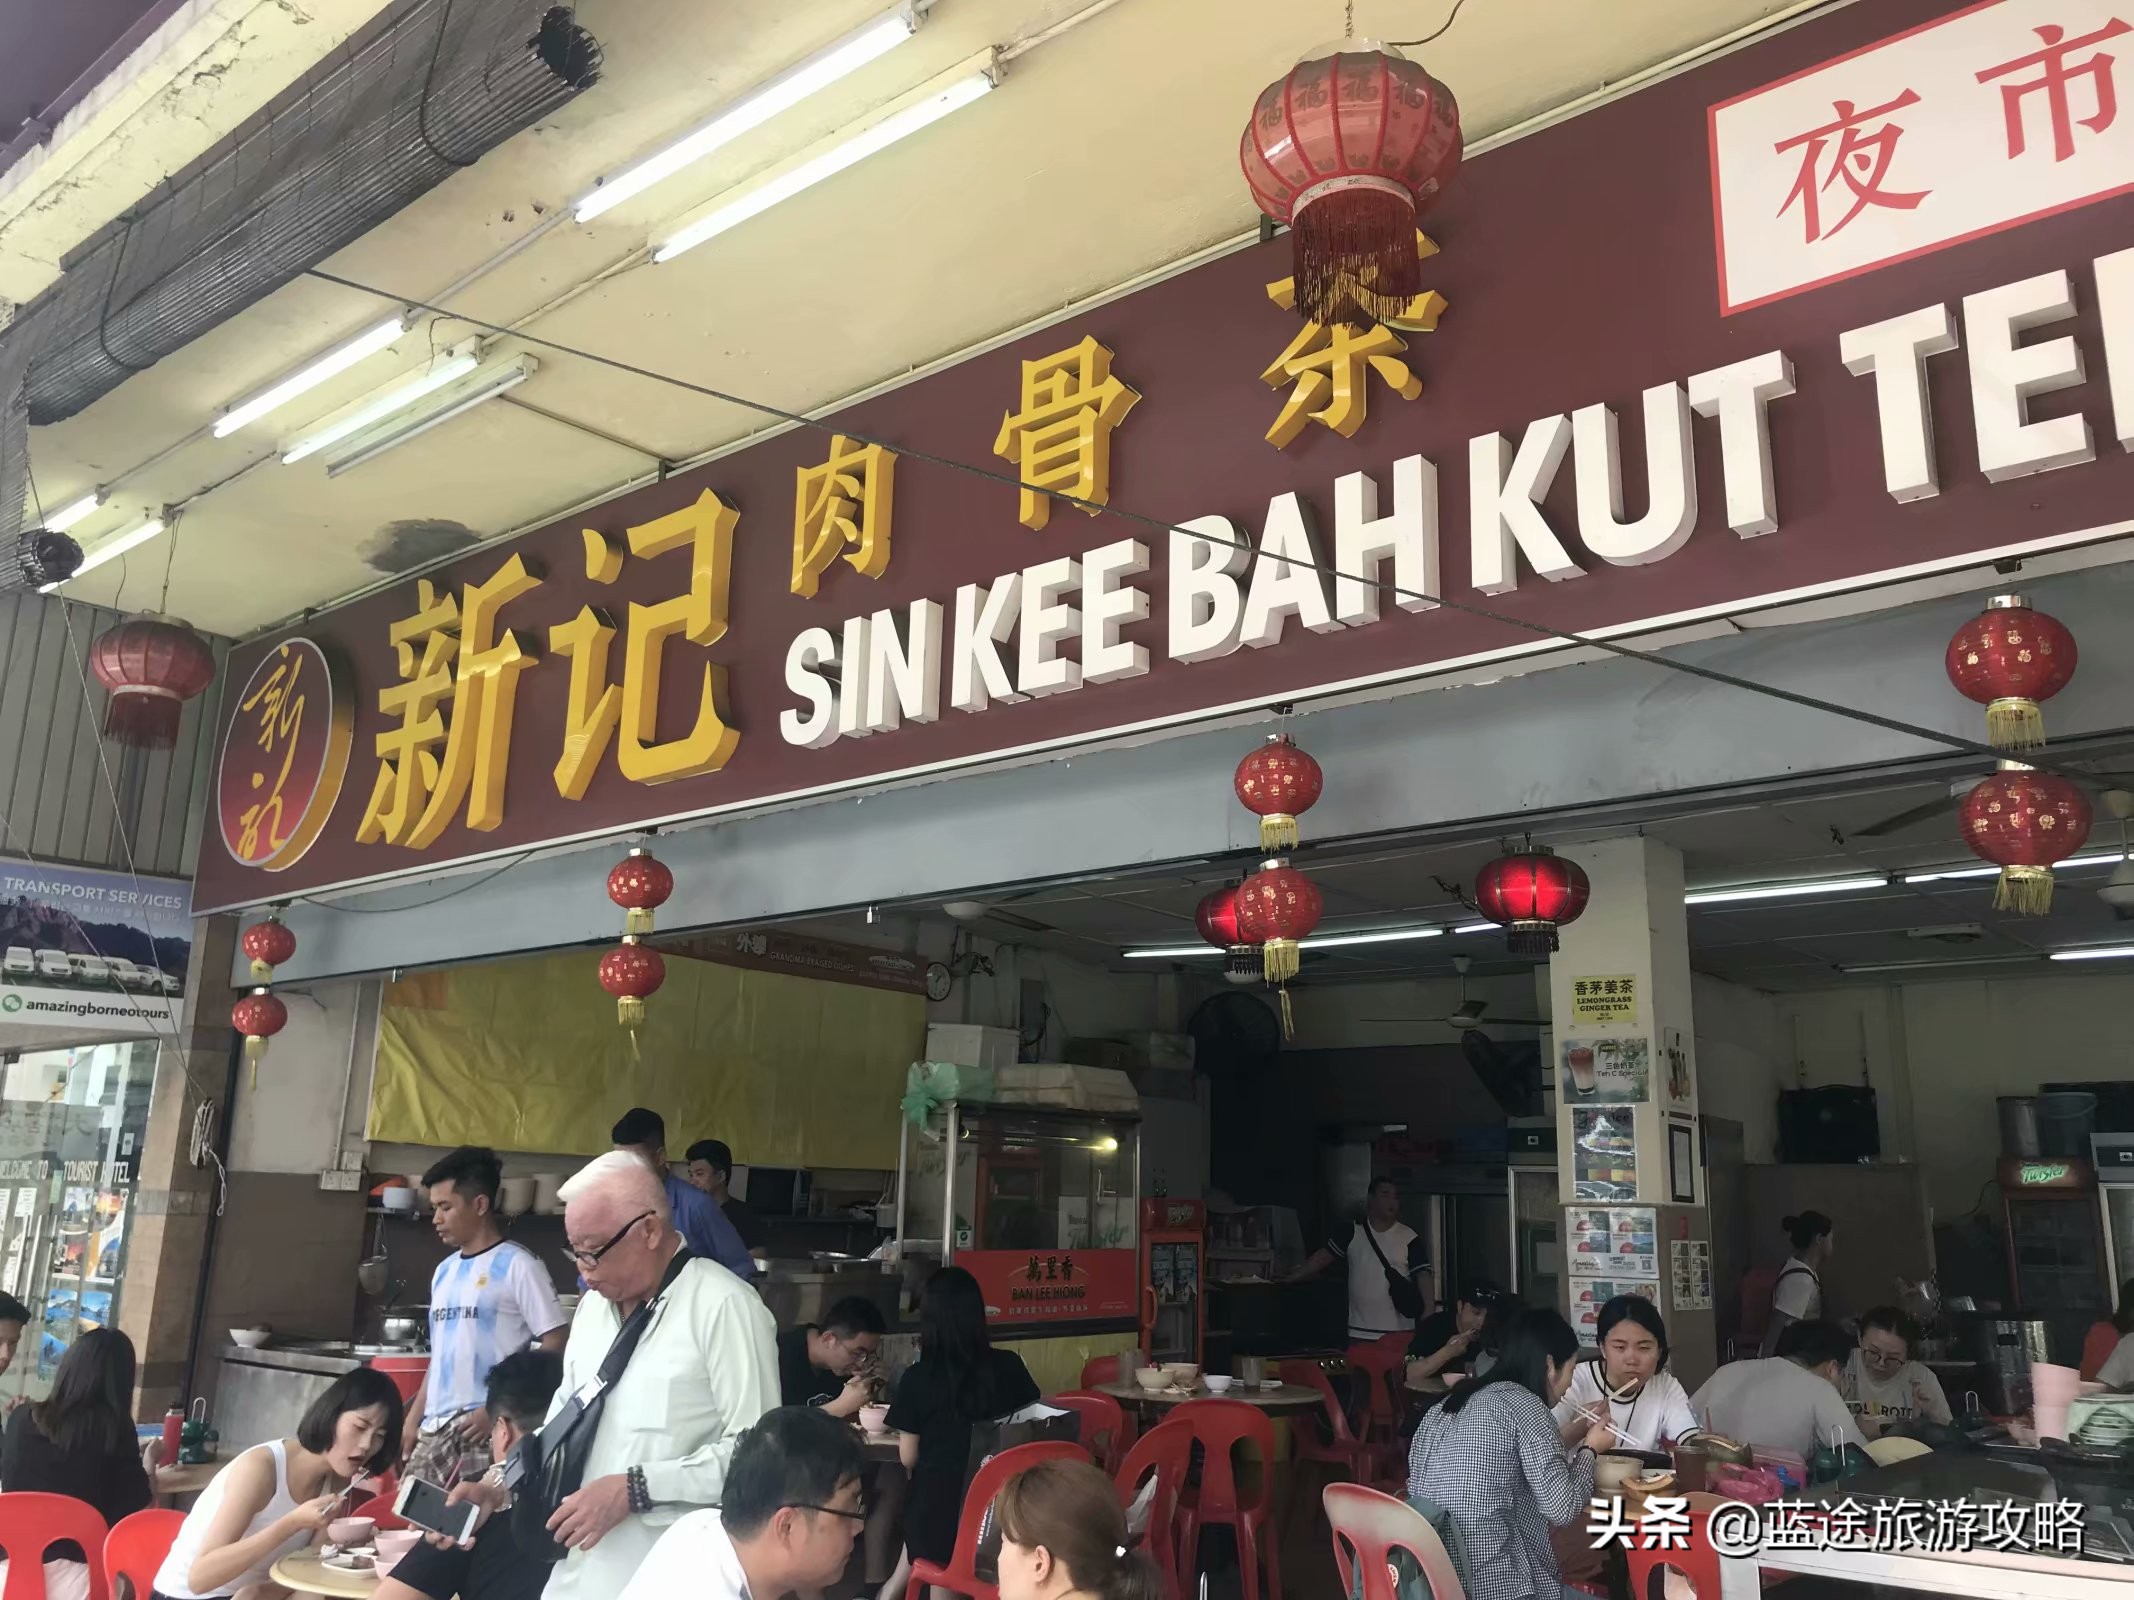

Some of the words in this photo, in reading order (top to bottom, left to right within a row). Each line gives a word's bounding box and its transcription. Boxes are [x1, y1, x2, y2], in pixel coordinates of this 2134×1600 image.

[1774, 16, 2133, 244] 夜市
[779, 598, 944, 749] SIN
[951, 537, 1151, 714] KEE
[1168, 453, 1441, 665] BAH
[1468, 349, 1797, 596] KUT
[355, 486, 741, 850] 新记
[4, 876, 107, 901] TRANSPORT
[1574, 979, 1634, 996] 香茅姜茶
[26, 1000, 170, 1020] amazingborneotours
[1576, 996, 1633, 1005] LEMONGRASS
[1612, 1003, 1629, 1011] TEA
[38, 1160, 49, 1180] TO
[64, 1160, 99, 1182] TOURIST
[100, 1161, 130, 1183] HTEL
[1012, 1287, 1033, 1301] BAN
[1035, 1286, 1051, 1300] LEE
[1053, 1284, 1086, 1299] HIONG
